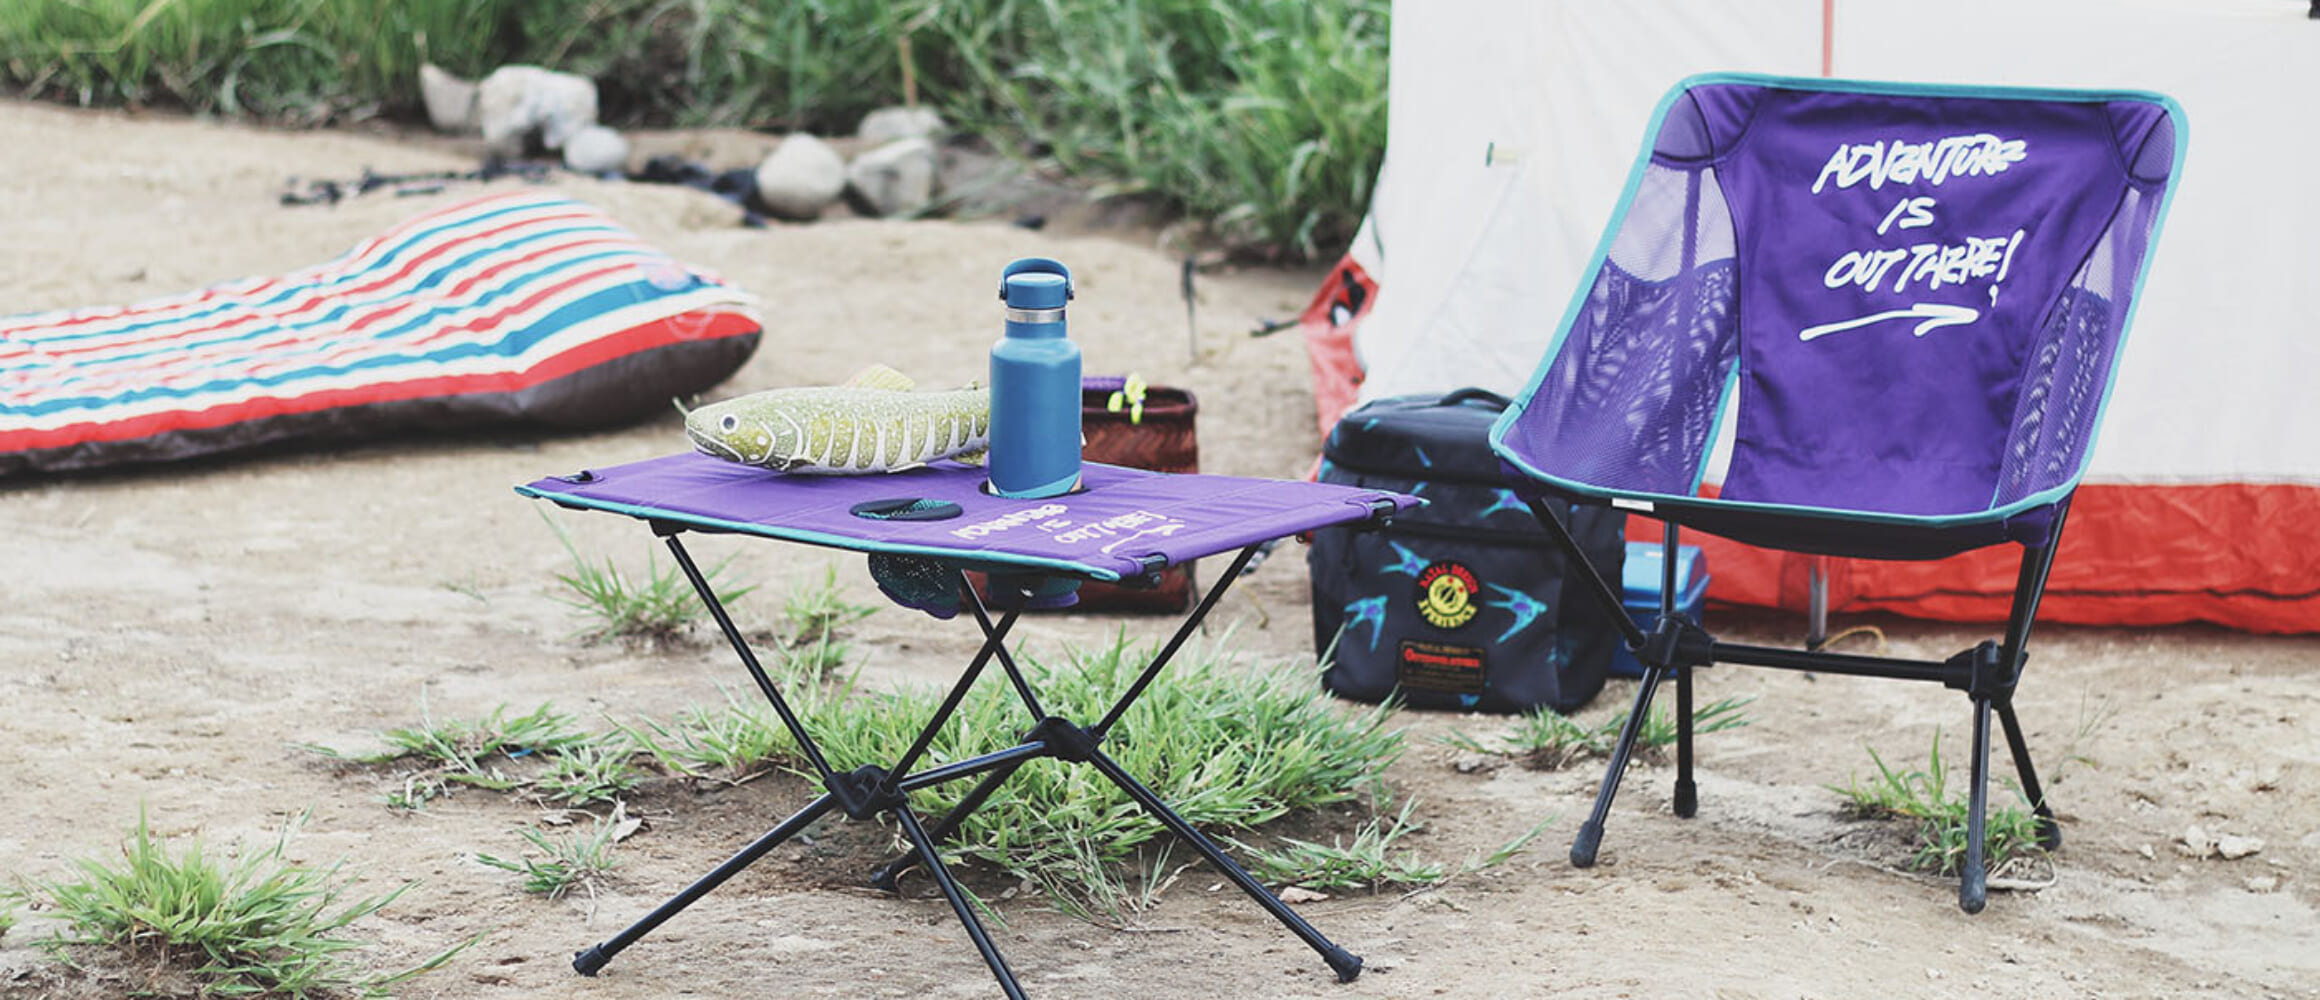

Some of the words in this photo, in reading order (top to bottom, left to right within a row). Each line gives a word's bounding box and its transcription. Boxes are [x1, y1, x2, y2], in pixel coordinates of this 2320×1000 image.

[1811, 133, 2028, 194] ADVENTURE
[1876, 196, 1937, 236] IS
[1824, 248, 1908, 293] OUT
